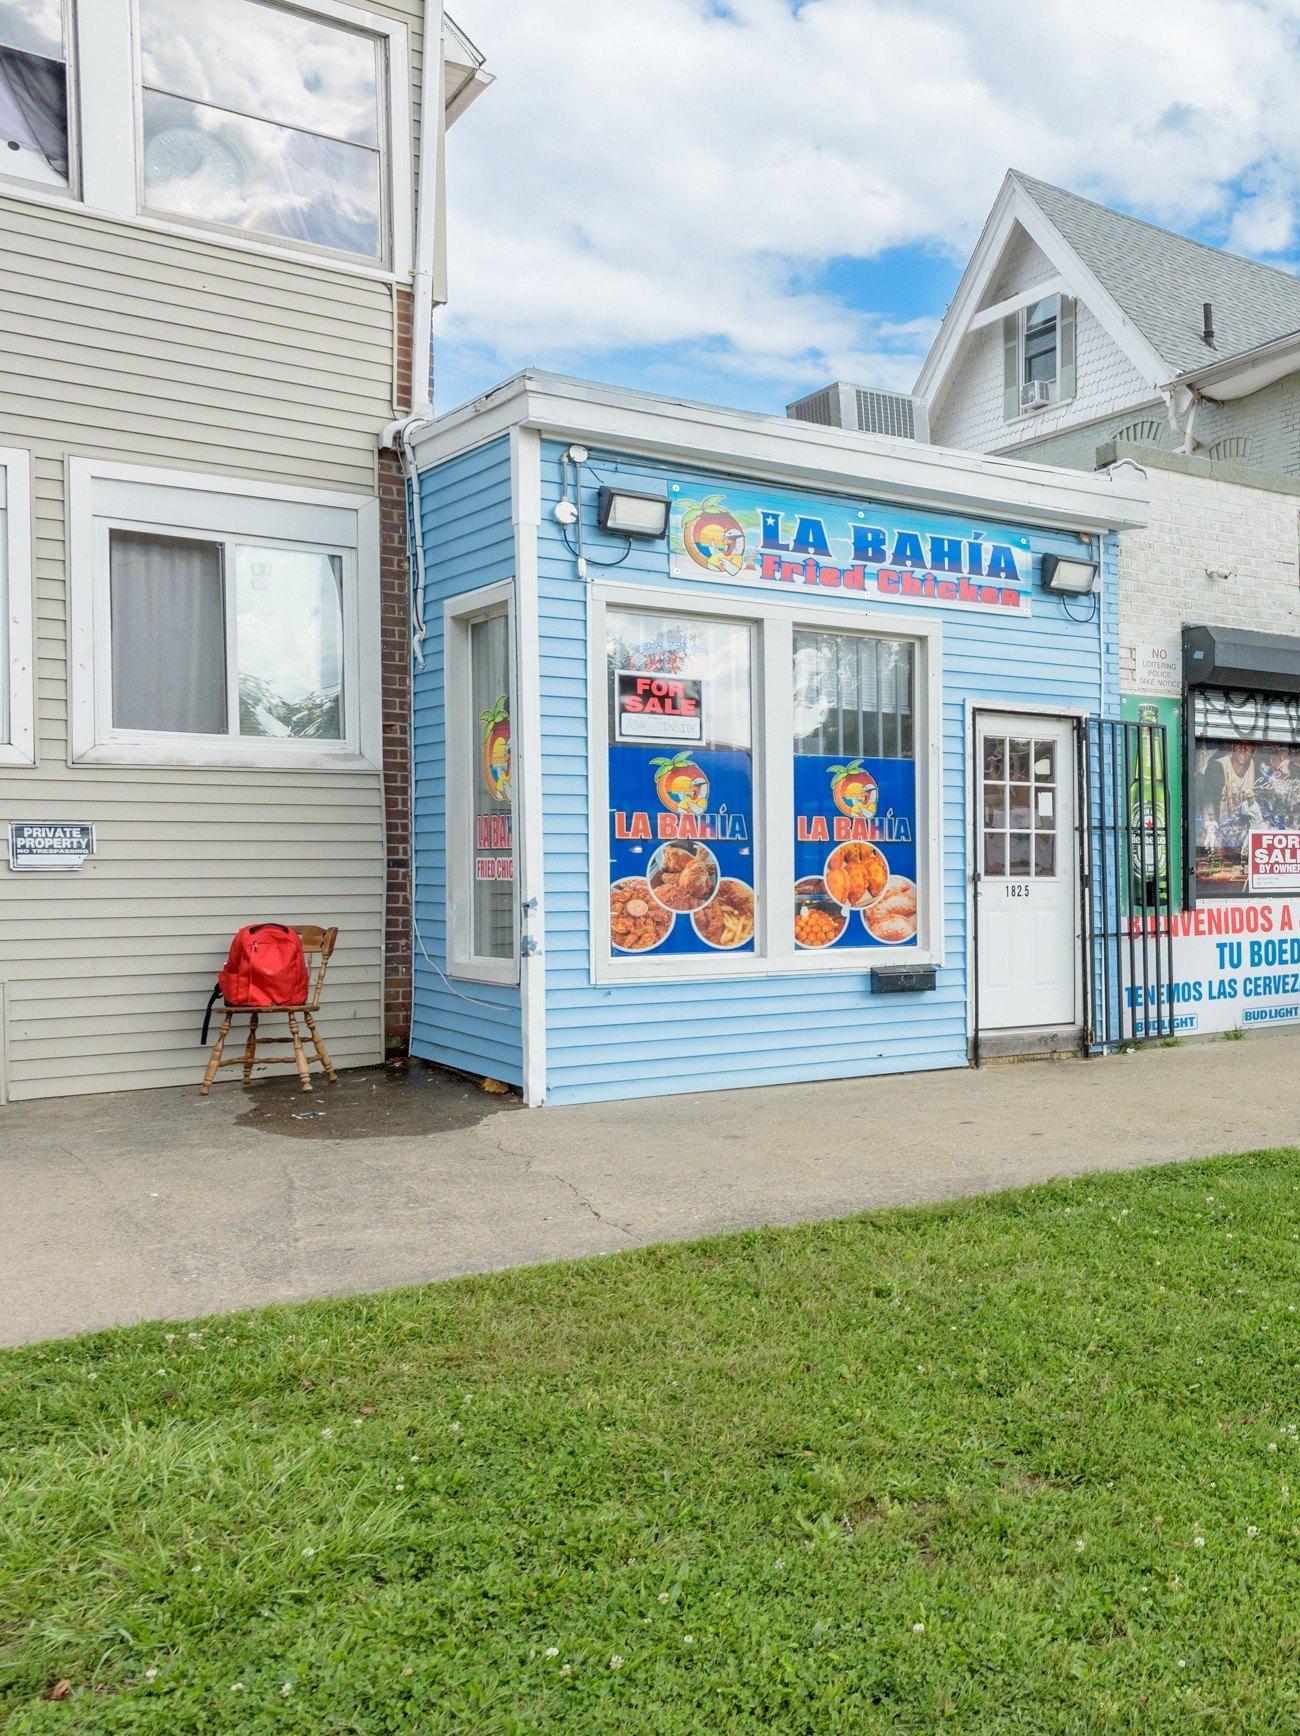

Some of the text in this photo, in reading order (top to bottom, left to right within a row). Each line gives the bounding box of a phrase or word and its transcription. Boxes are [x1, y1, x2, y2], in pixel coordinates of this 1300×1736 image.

[757, 509, 1022, 582] LA BAHÍA
[759, 553, 1021, 608] Fried Chicken
[1152, 649, 1167, 660] NO
[1142, 660, 1176, 671] LOITERING
[1140, 678, 1181, 688] TAKE NOTICE
[1148, 670, 1172, 679] POLICE
[636, 678, 684, 697] FOR
[624, 695, 697, 716] SALE
[614, 803, 748, 840] LA BAHÍA
[798, 808, 912, 842] LA BAHÍA
[24, 827, 81, 838] PRIVATE
[477, 815, 490, 850] LA
[16, 838, 88, 848] PROPERTY
[1262, 835, 1300, 848] FOR
[477, 858, 496, 878] FRIED
[1259, 864, 1270, 874] BY
[1006, 885, 1030, 898] 1825
[1126, 906, 1273, 939] BENVENIDOS
[1280, 905, 1293, 931] A
[1216, 941, 1242, 969] TU
[1124, 981, 1202, 1008] TENEMOS
[1208, 978, 1238, 1000] LAS
[1245, 1006, 1300, 1021] BUD LIGHT
[1158, 1016, 1196, 1030] LGHT
